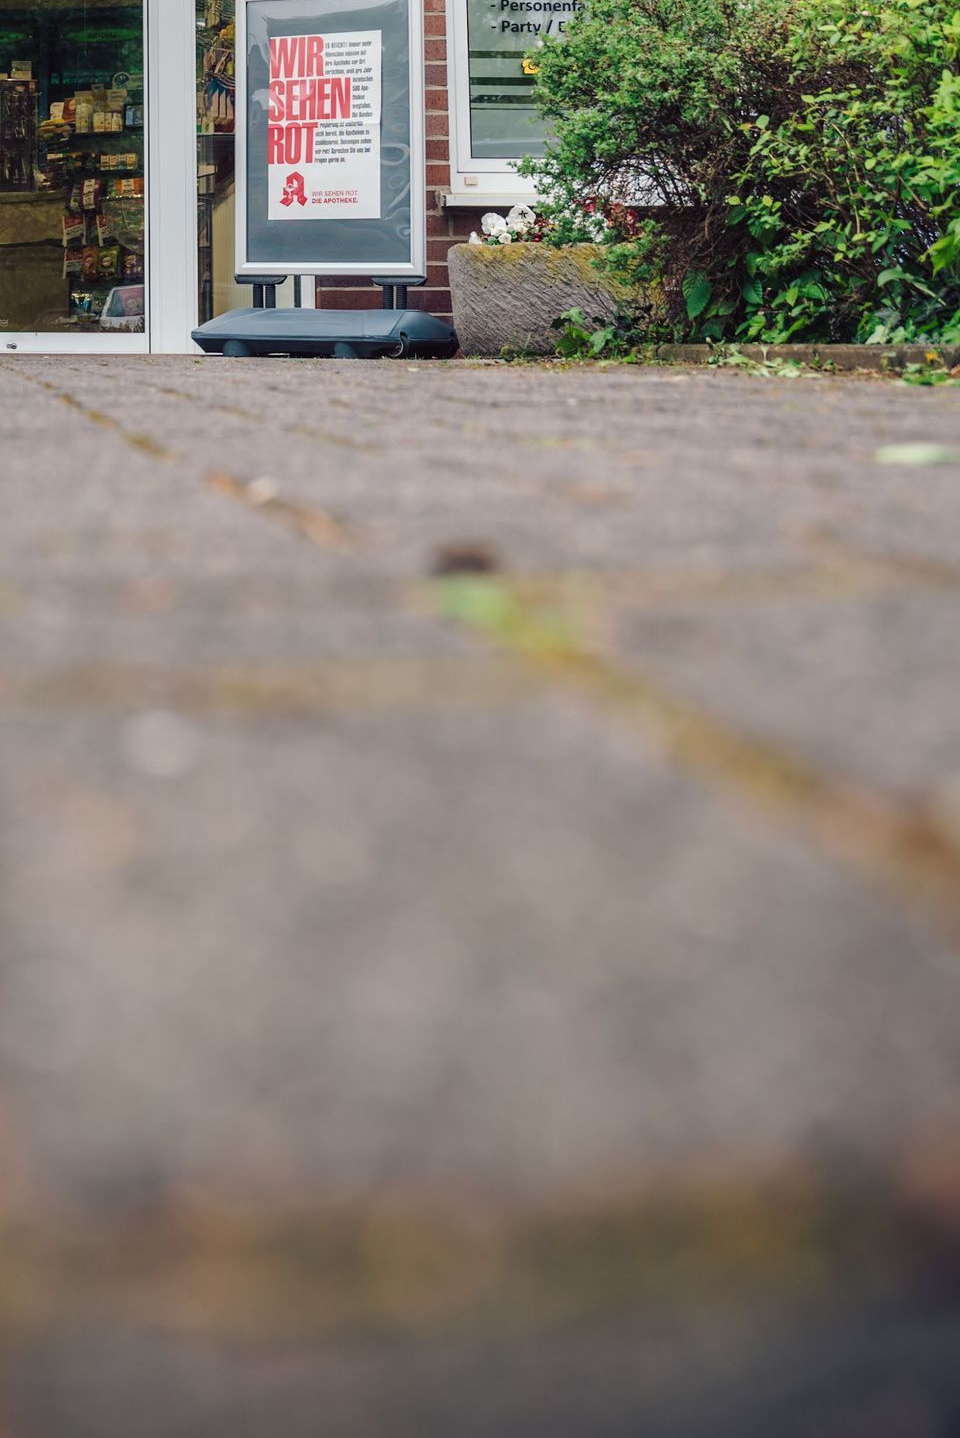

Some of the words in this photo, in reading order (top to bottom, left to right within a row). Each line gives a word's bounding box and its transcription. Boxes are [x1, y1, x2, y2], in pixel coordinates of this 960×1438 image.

[501, 21, 541, 35] Party
[269, 36, 324, 78] WIR
[269, 77, 351, 122] SEHEN
[268, 122, 318, 165] ROT
